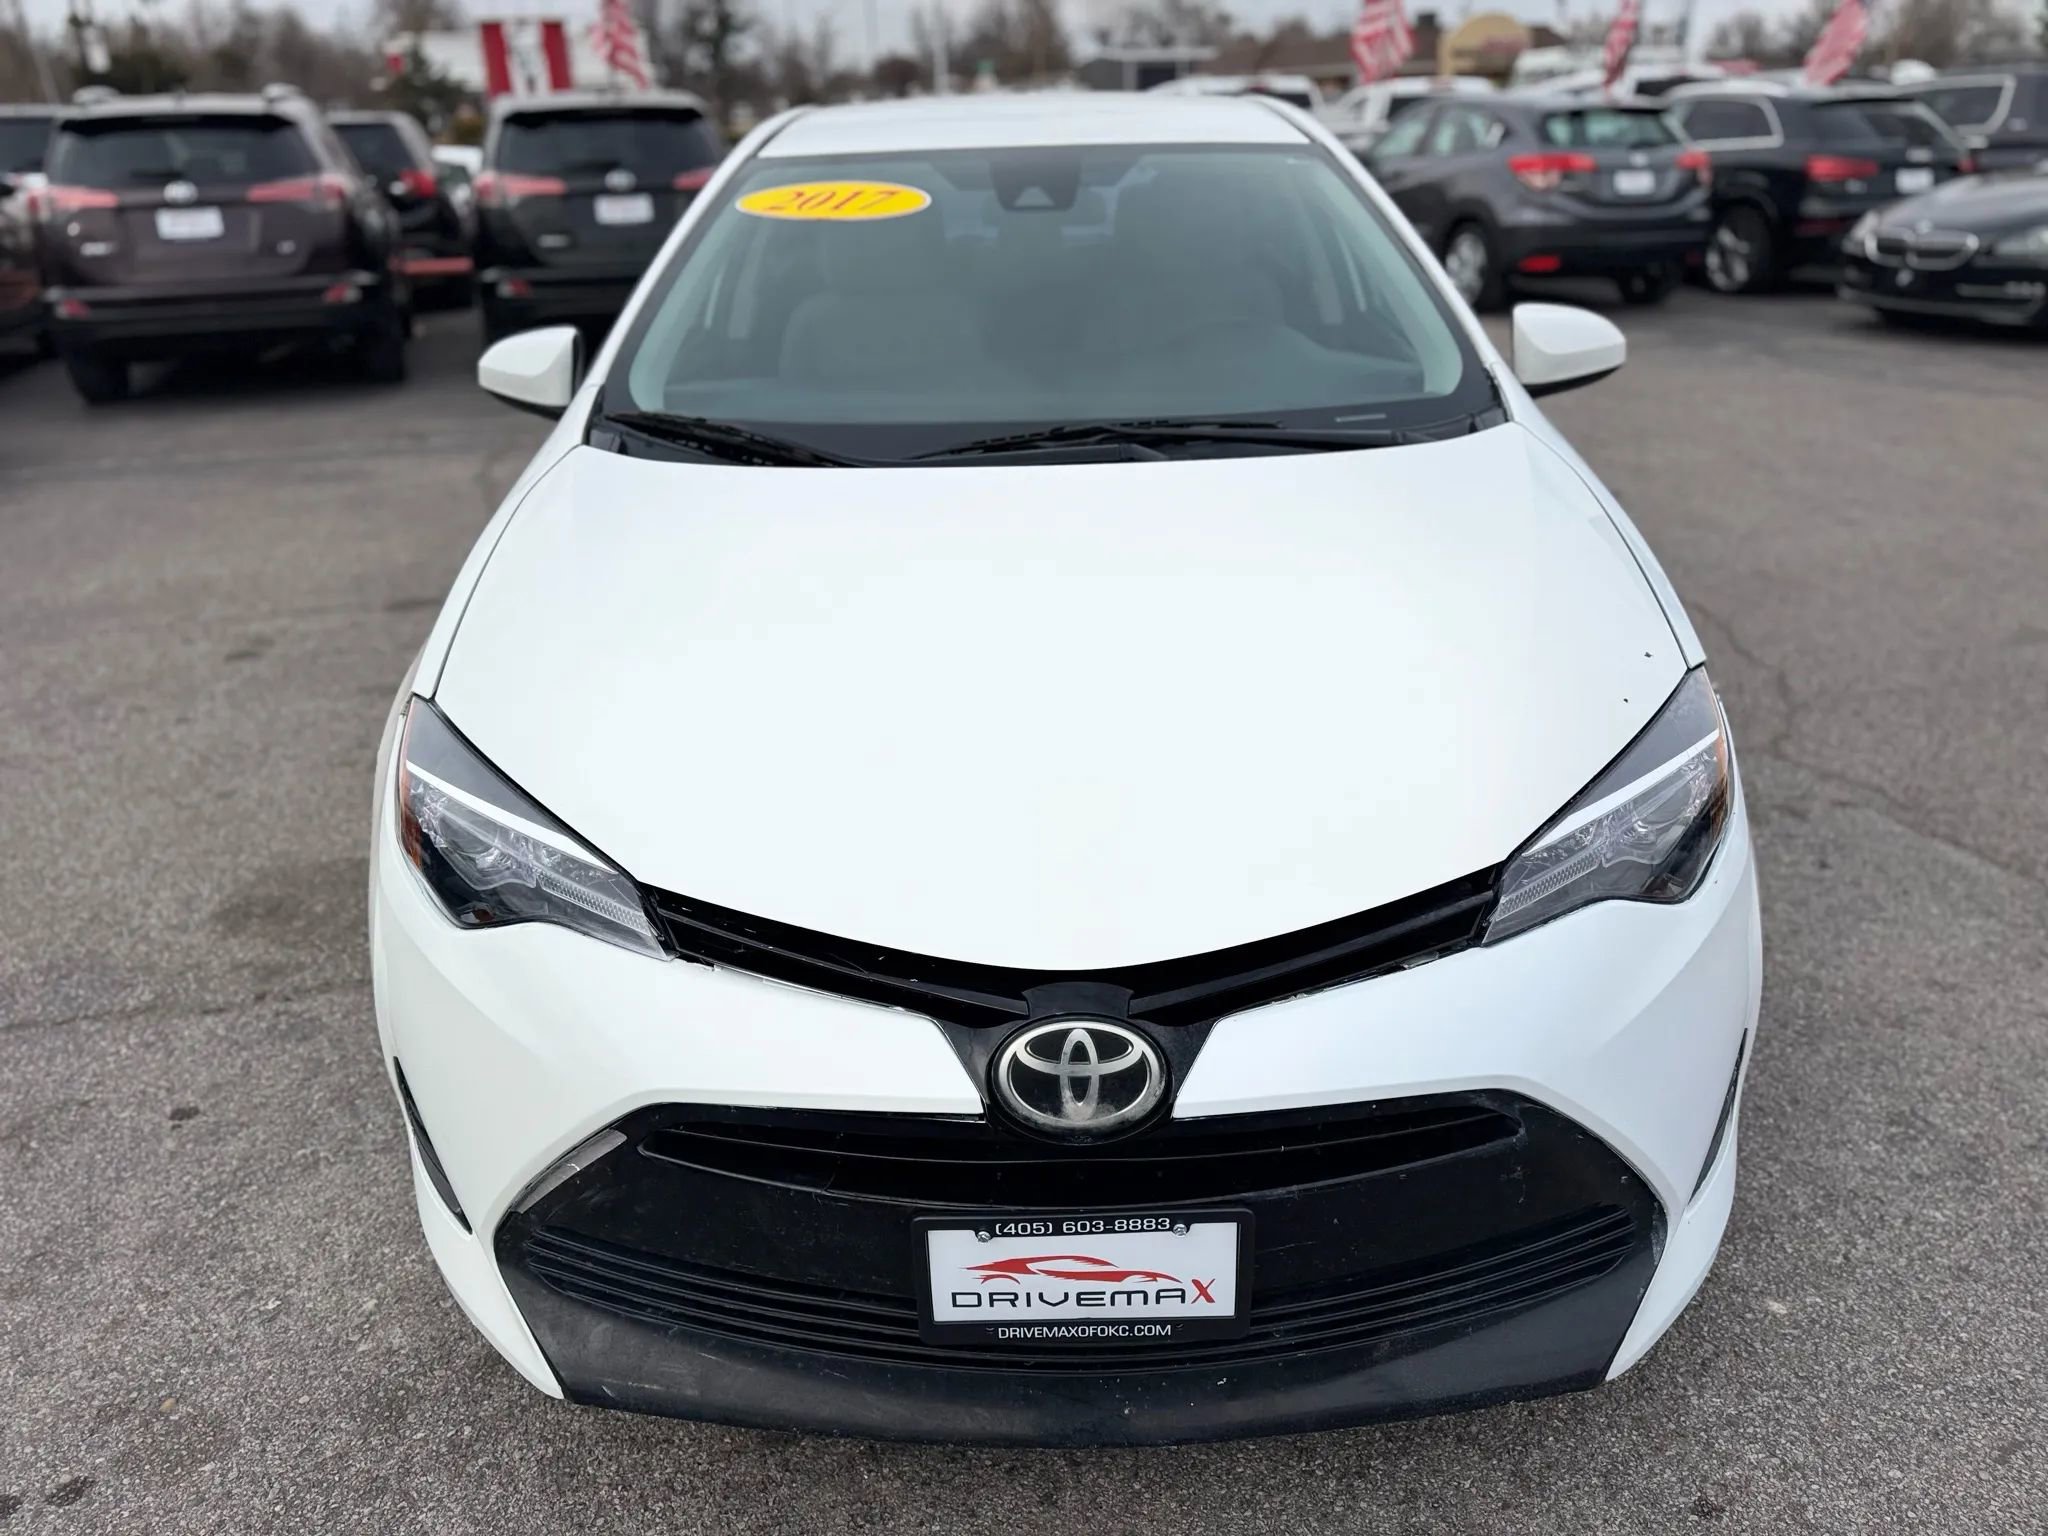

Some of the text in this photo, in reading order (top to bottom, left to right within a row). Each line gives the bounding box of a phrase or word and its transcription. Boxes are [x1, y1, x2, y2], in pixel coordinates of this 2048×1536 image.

[763, 190, 901, 212] 2017
[995, 1218, 1171, 1236] (405) 603-8883
[951, 1278, 1216, 1308] DRIVEMAX
[998, 1324, 1172, 1340] DRIVEMAXOFOKC.COM
